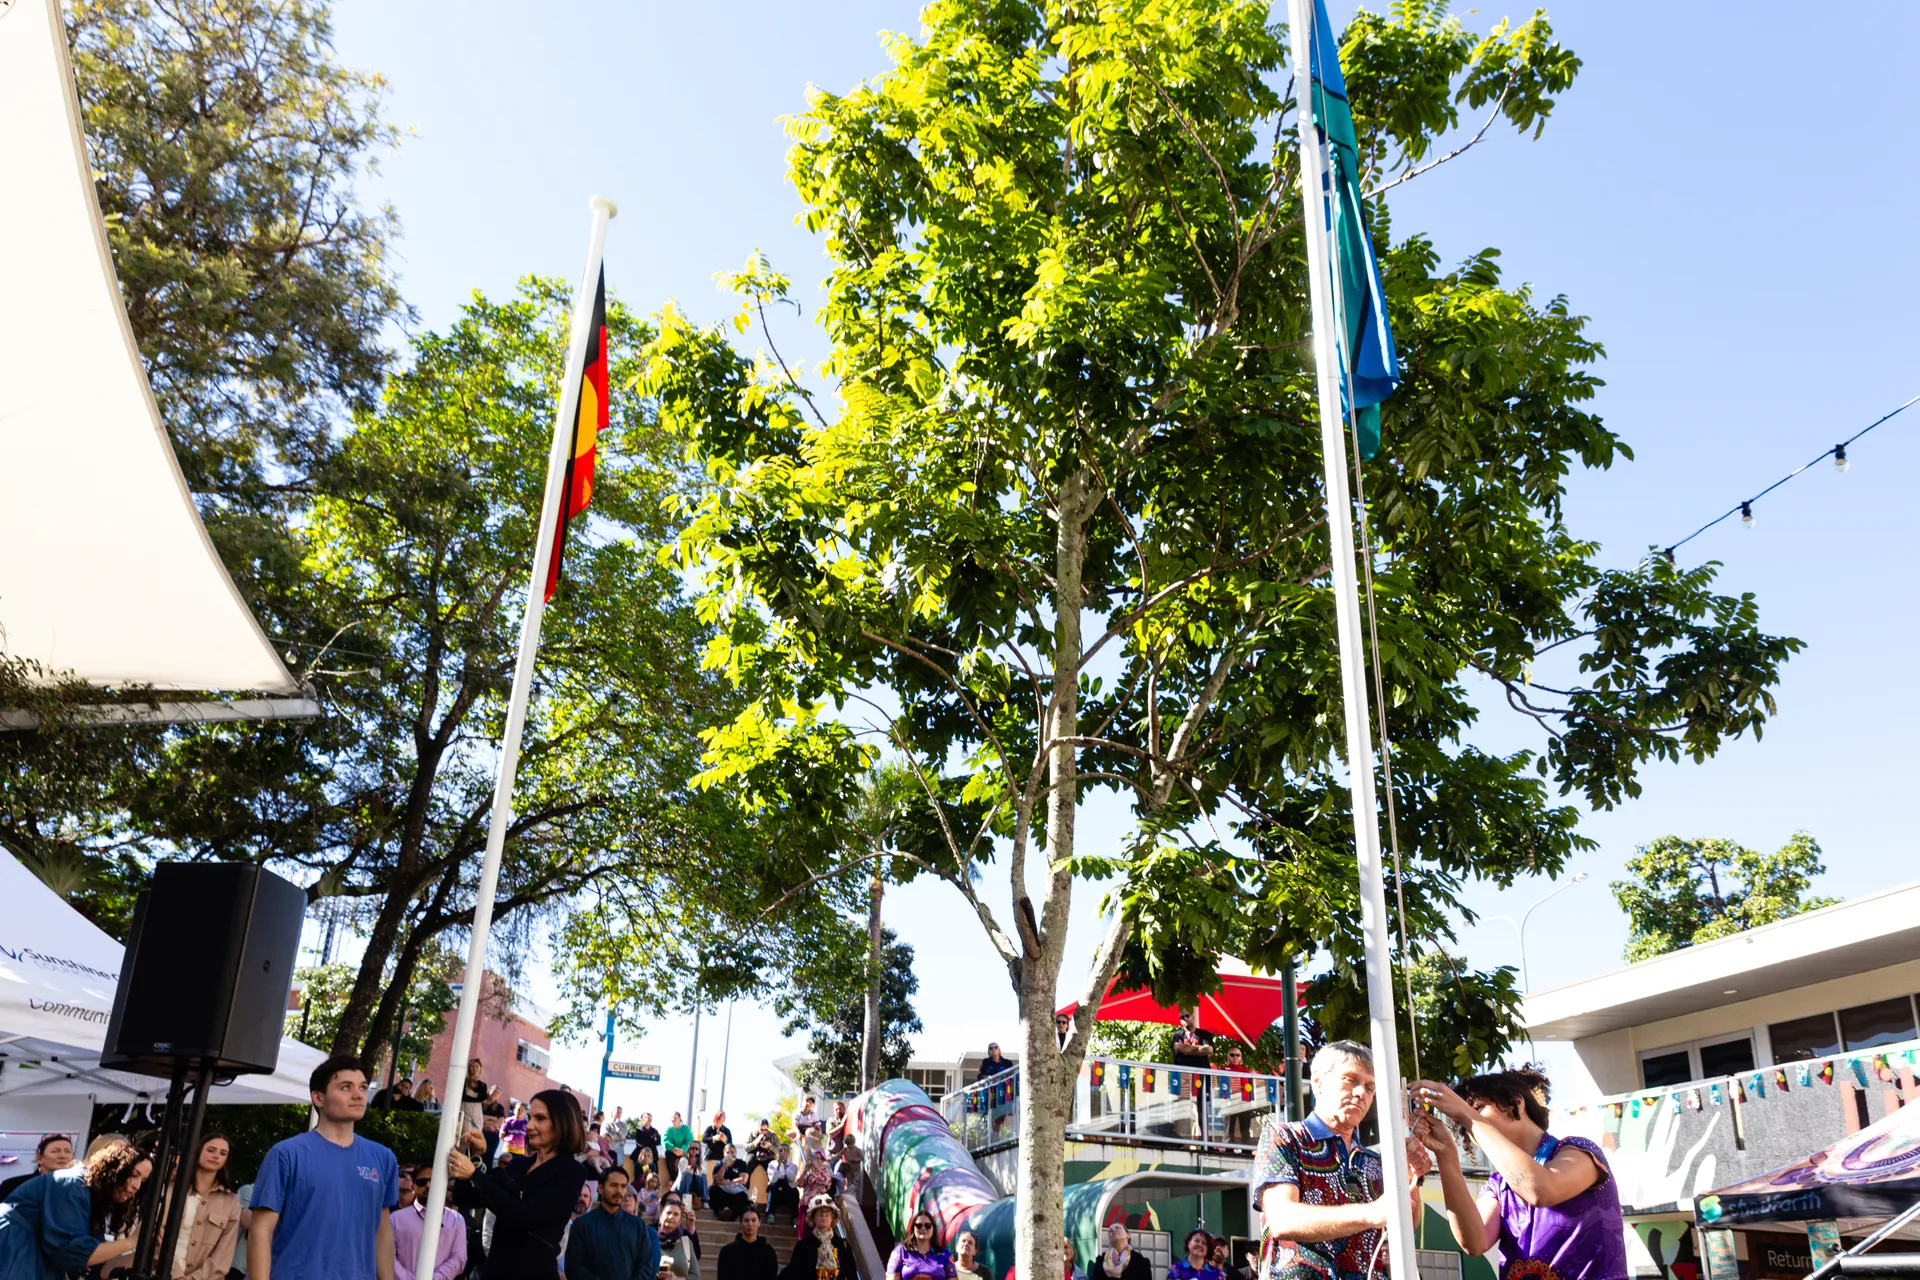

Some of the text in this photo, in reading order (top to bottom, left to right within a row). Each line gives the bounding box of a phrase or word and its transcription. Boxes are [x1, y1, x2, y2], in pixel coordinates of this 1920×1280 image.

[23, 948, 111, 981] Sunshine
[29, 998, 112, 1025] Communi
[613, 1063, 644, 1072] CURRIE
[1728, 1191, 1821, 1217] shadforth
